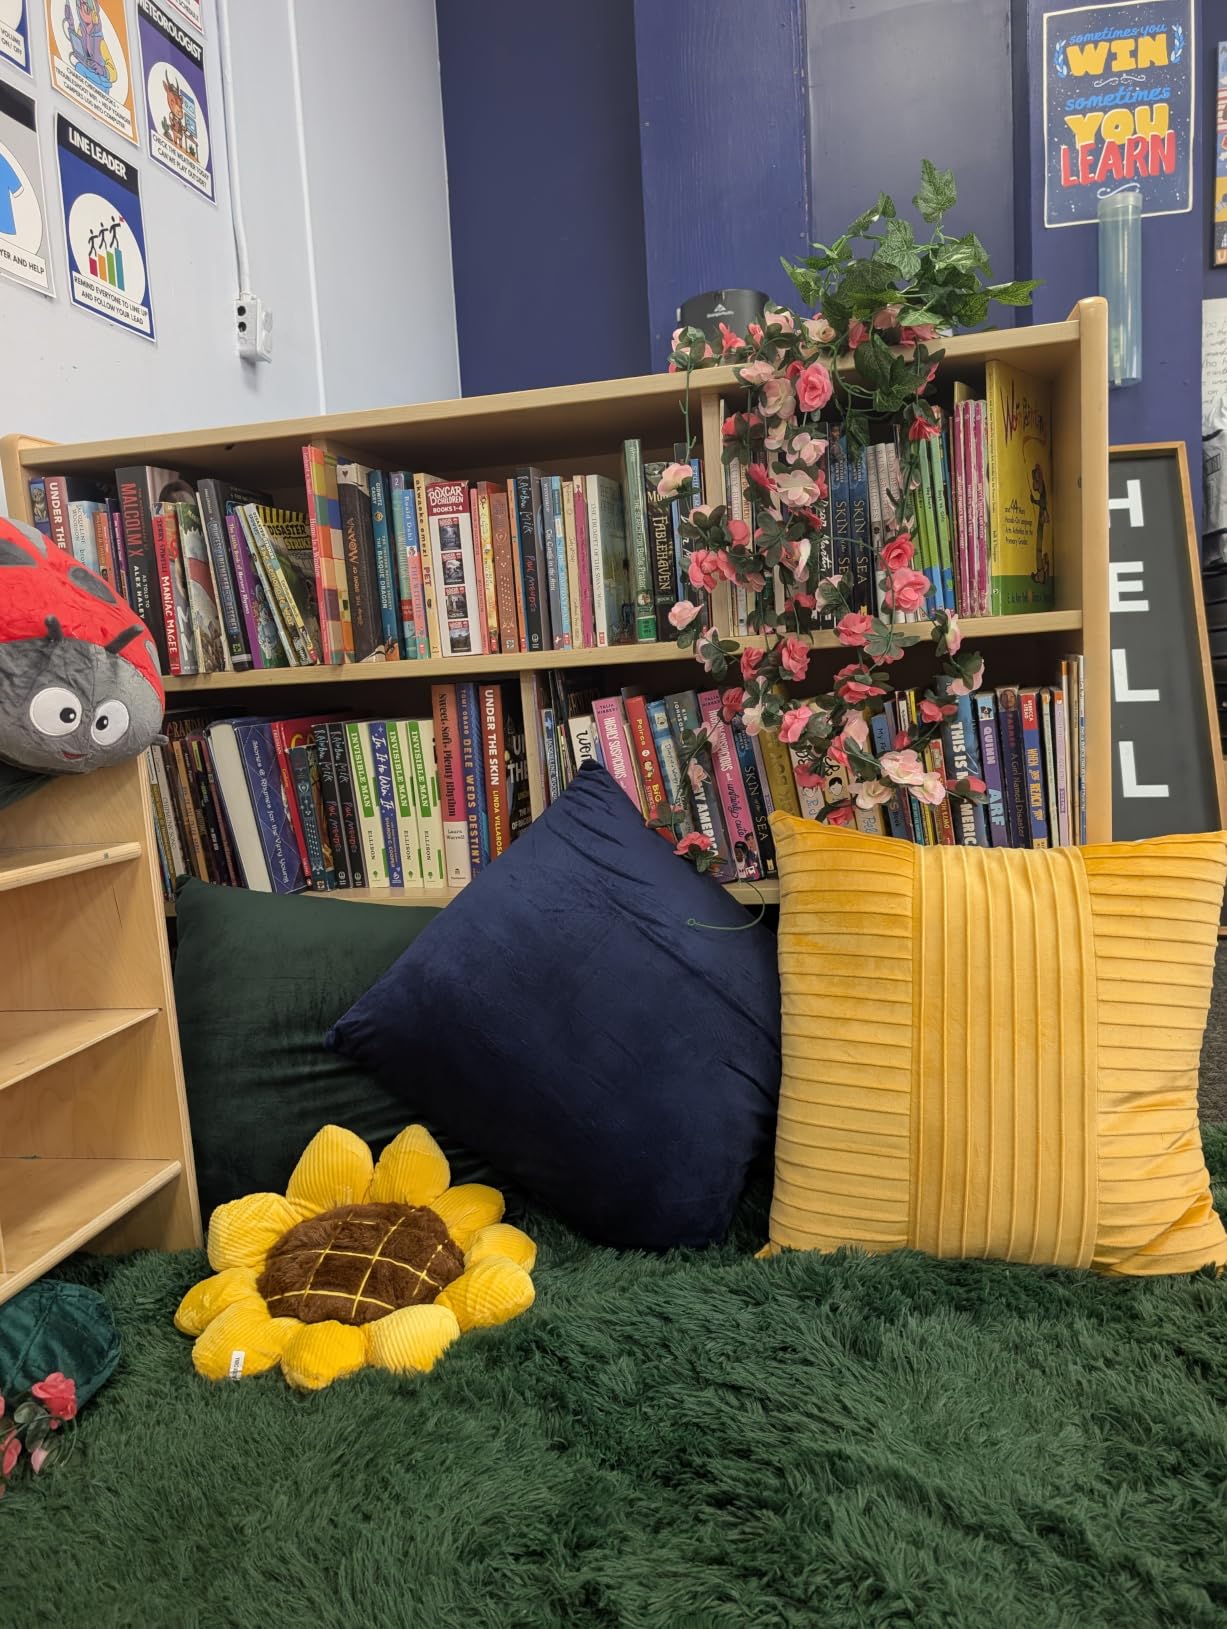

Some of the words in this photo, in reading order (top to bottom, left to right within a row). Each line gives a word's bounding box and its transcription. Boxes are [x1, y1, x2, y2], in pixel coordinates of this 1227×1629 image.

[139, 0, 202, 60] METEOROLOGIST
[1070, 26, 1139, 44] sometimes
[1140, 22, 1169, 39] you
[1066, 34, 1169, 77] WIN
[84, 77, 118, 107] CHROMEBOOKS
[1064, 85, 1172, 112] sometimes
[103, 108, 126, 129] COMPUTER
[111, 106, 131, 126] YOUNGER
[1064, 103, 1170, 148] YOU
[68, 127, 92, 156] LINE
[90, 138, 127, 181] LEADER
[153, 134, 169, 150] CHECK
[195, 165, 210, 182] TODAY
[1060, 130, 1177, 188] LEARN
[13, 254, 28, 268] AND
[28, 261, 45, 275] HELP
[73, 275, 95, 292] REMIND
[95, 285, 122, 307] EVERYONE
[121, 298, 129, 309] TO
[129, 303, 140, 315] LINE
[81, 290, 94, 301] AND
[93, 296, 115, 312] FOLLOW
[116, 306, 130, 318] YOUR
[130, 313, 144, 325] LEAD
[375, 482, 383, 507] GIDWITZ
[404, 495, 412, 519] Roald
[428, 486, 464, 506] BOXCAR
[437, 496, 464, 505] CHILDREN
[543, 482, 551, 513] WINTHROP
[50, 482, 64, 524] UNDER
[58, 526, 67, 550] THE
[76, 504, 86, 545] JACQUELINE
[120, 483, 143, 547] MALCOLM
[415, 480, 425, 524] akwaeke
[420, 528, 429, 558] emezi
[433, 506, 453, 514] BOOKS
[634, 511, 643, 534] SEARCH
[835, 501, 848, 535] SKIN
[853, 499, 867, 533] SKIN
[228, 523, 236, 534] The
[230, 534, 238, 550] Little
[267, 524, 307, 536] DISASTER
[346, 518, 359, 564] MOANA
[406, 521, 414, 541] Dahl
[592, 518, 600, 547] TRUMPET
[636, 534, 644, 547] FOR
[128, 547, 144, 557] X
[309, 517, 317, 538] Home
[313, 551, 321, 578] Window
[636, 548, 645, 566] Belle
[652, 515, 672, 591] FABLEHAVEN
[134, 565, 143, 588] ALEX
[142, 574, 149, 582] AS
[377, 550, 385, 578] BASQUE
[423, 566, 432, 587] PET
[637, 566, 647, 589] Prater
[857, 556, 869, 585] SEA
[238, 571, 246, 592] Nursery
[379, 580, 388, 609] DRAGON
[136, 590, 146, 619] HALEY
[145, 601, 151, 609] TO
[241, 593, 250, 614] Rhymes
[164, 619, 179, 654] MAGEE
[484, 689, 496, 731] UNDER
[673, 701, 685, 732] JOHNSON
[1023, 703, 1031, 719] STEAD
[1027, 700, 1035, 722] REBECCA
[272, 729, 283, 755] FREEMAN
[371, 735, 386, 750] In
[603, 716, 619, 741] HIGHLY
[636, 718, 647, 746] Peirce
[876, 728, 884, 739] My
[950, 721, 967, 752] THIS
[376, 752, 388, 764] It
[389, 731, 404, 783] INVISIBLE
[411, 731, 426, 783] INVISIBLE
[463, 738, 473, 769] DELE
[487, 733, 498, 756] THE
[546, 737, 557, 775] JACQUELINE
[983, 726, 996, 765] QUINN
[1026, 748, 1040, 767] WHEN
[377, 764, 386, 774] to
[443, 750, 455, 781] Plenty
[489, 757, 500, 786] SKIN
[608, 740, 627, 779] SUSPICIOUS
[956, 755, 969, 769] IS
[1012, 762, 1021, 776] Girl
[352, 732, 367, 783] INVISIBLE
[362, 784, 371, 808] MAN
[367, 830, 376, 860] ELLISON
[377, 775, 390, 796] Win
[399, 784, 408, 808] MAN
[420, 784, 429, 808] MAN
[446, 781, 458, 817] Rhythm
[465, 774, 477, 809] WEDS
[1013, 777, 1024, 803] Named
[1030, 783, 1043, 807] REACH
[380, 798, 395, 810] It
[492, 790, 501, 814] LINDA
[726, 783, 740, 819] unfairly
[735, 819, 748, 838] cute
[744, 765, 759, 797] SKIN
[755, 815, 769, 841] SEA
[988, 788, 1006, 827] ARF
[260, 778, 272, 809] Rhymes
[266, 810, 275, 823] for
[271, 824, 279, 836] the
[278, 858, 290, 884] Young
[1015, 804, 1026, 838] Disaster
[384, 817, 392, 838] SHARON
[388, 846, 397, 868] COOPER
[403, 830, 412, 860] ELLISON
[424, 830, 433, 860] ELLISON
[468, 814, 481, 864] DESTINY
[493, 815, 504, 857] VILLAROSA
